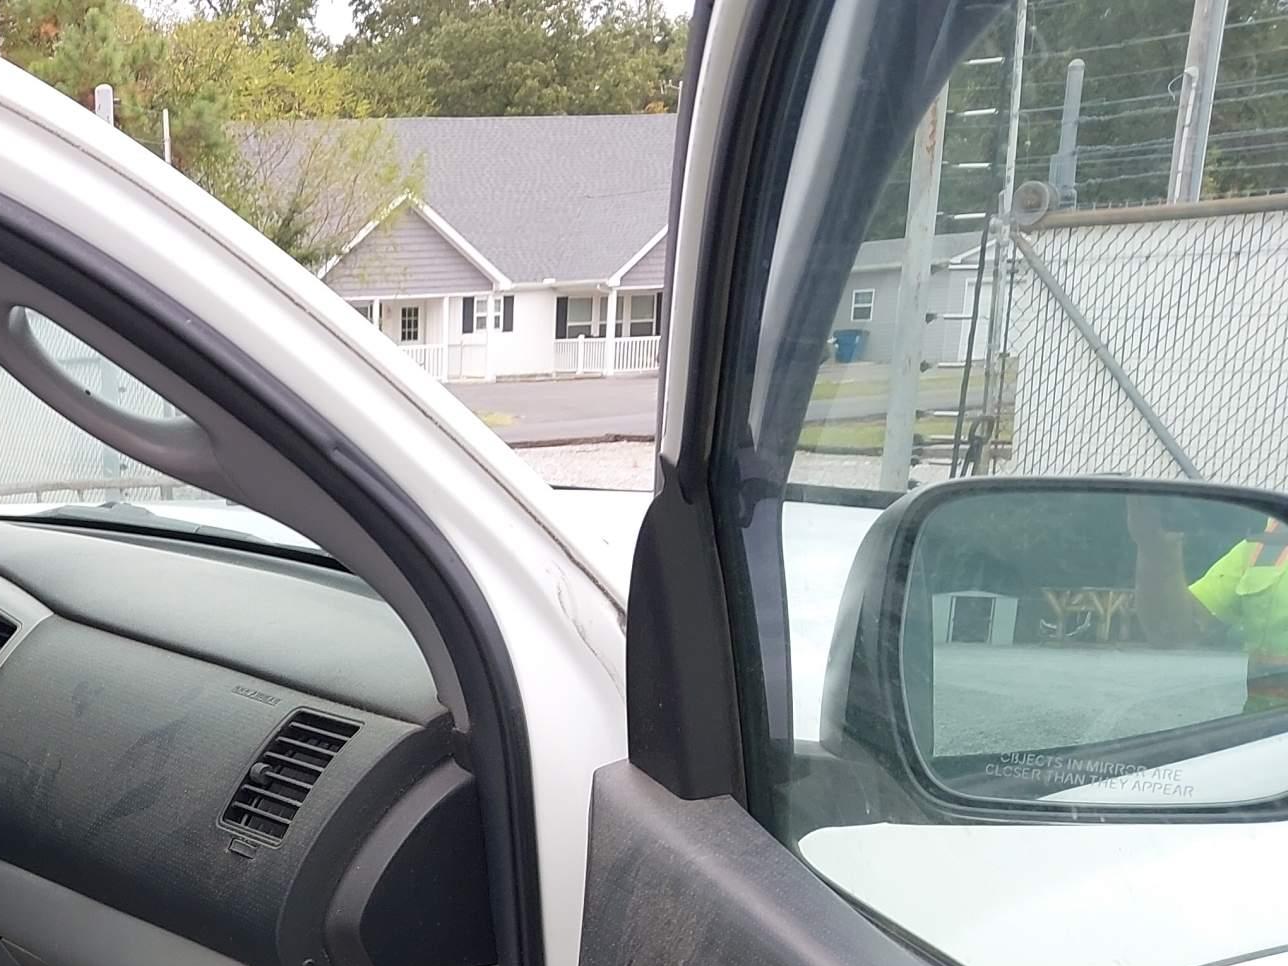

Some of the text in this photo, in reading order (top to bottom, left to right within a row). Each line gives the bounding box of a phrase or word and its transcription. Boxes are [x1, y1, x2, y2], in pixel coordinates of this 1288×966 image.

[985, 763, 1194, 798] CLOSER THAN THEY APPEAR
[1000, 752, 1183, 782] OBJECTS IN MIRROR ARE
